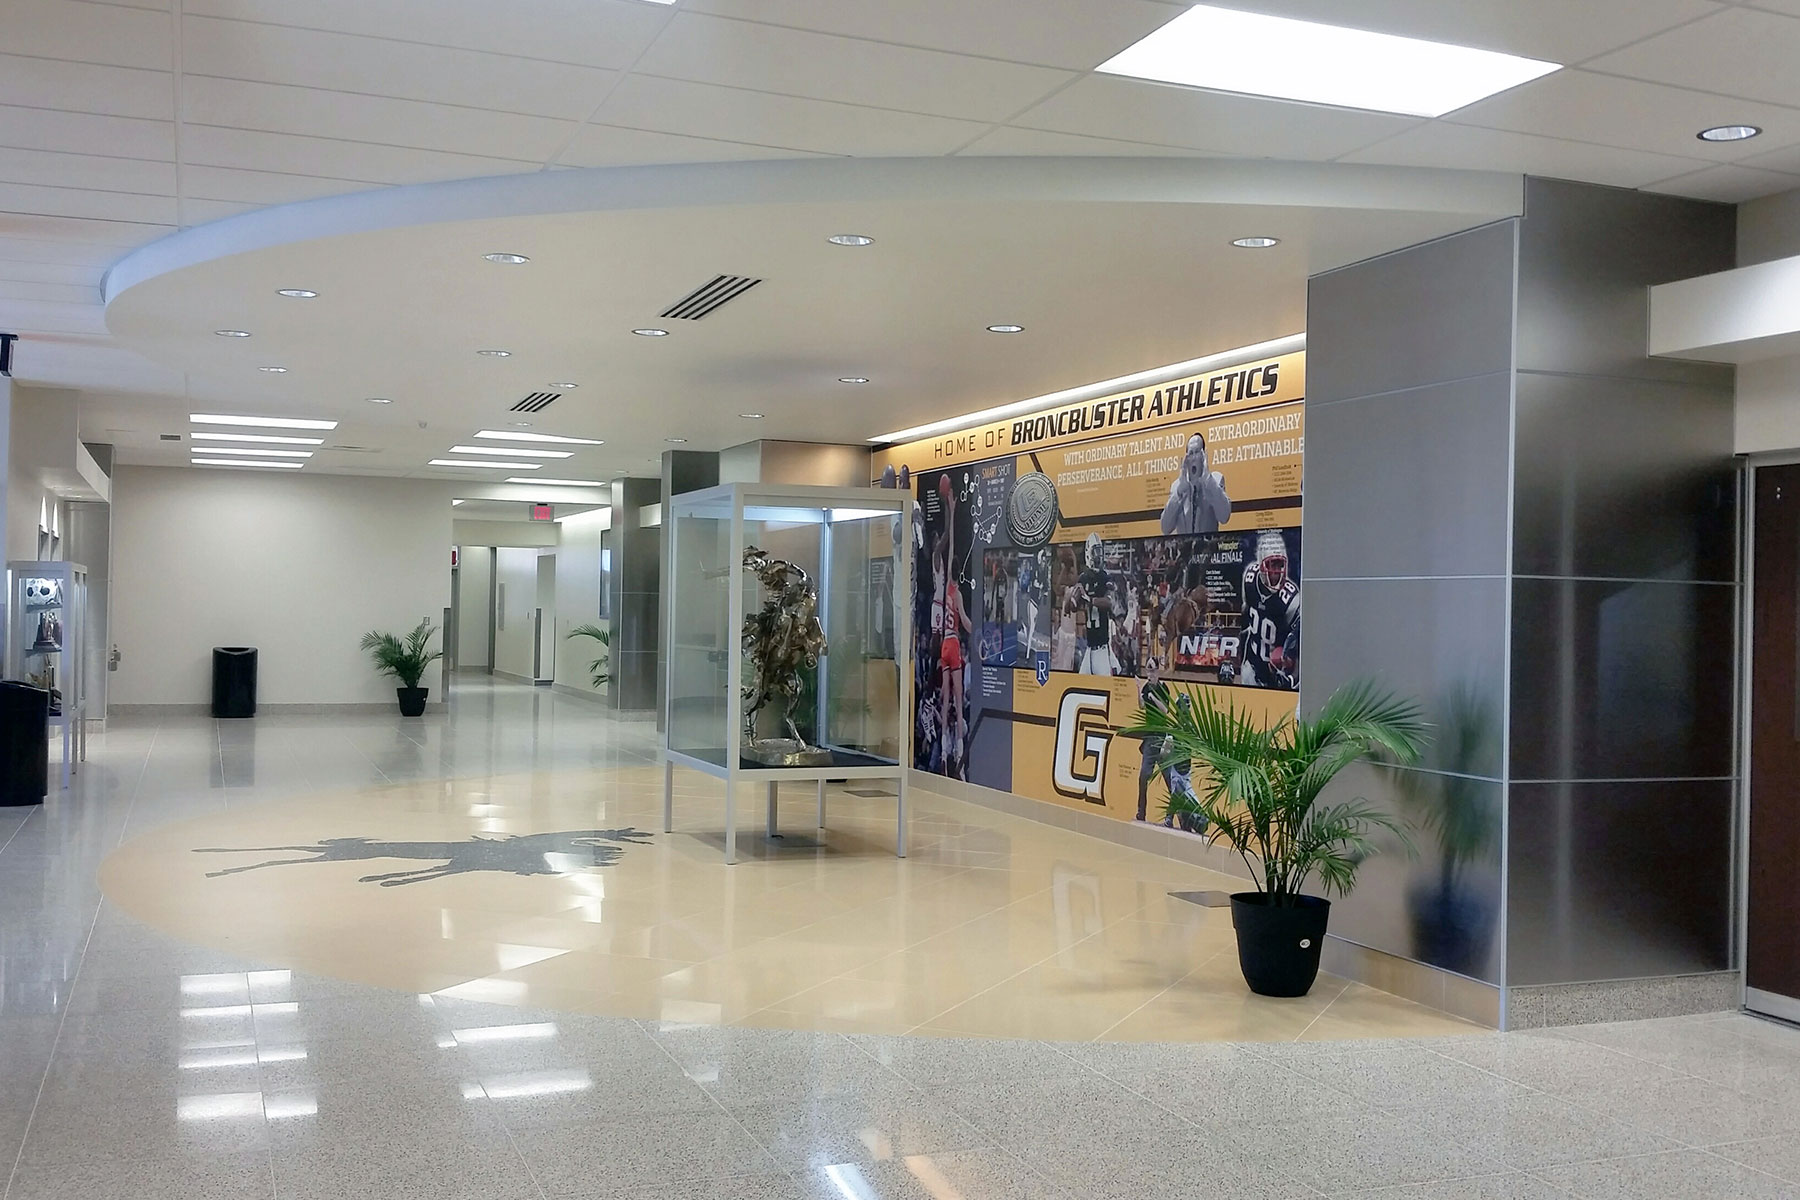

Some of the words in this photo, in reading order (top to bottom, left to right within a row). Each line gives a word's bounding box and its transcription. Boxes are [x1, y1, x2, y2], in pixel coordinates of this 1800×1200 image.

[934, 435, 976, 459] HOME
[985, 428, 1006, 448] OF
[1010, 394, 1145, 446] BRONCBUSTER
[1147, 363, 1279, 419] ATHLETICS
[1064, 449, 1085, 466] WITH
[1085, 443, 1128, 463] ORDINARY
[1129, 437, 1163, 456] TALENT
[1164, 433, 1185, 450] AND
[1208, 413, 1301, 443] EXTRAORDINARY
[982, 466, 998, 479] SMART
[998, 463, 1011, 477] SHOT
[1127, 461, 1143, 478] ALL
[1144, 455, 1179, 475] THINGS
[1212, 447, 1234, 465] ARE
[1235, 437, 1304, 462] ATTAINABLE
[1180, 635, 1240, 658] NFR
[1037, 660, 1048, 681] R
